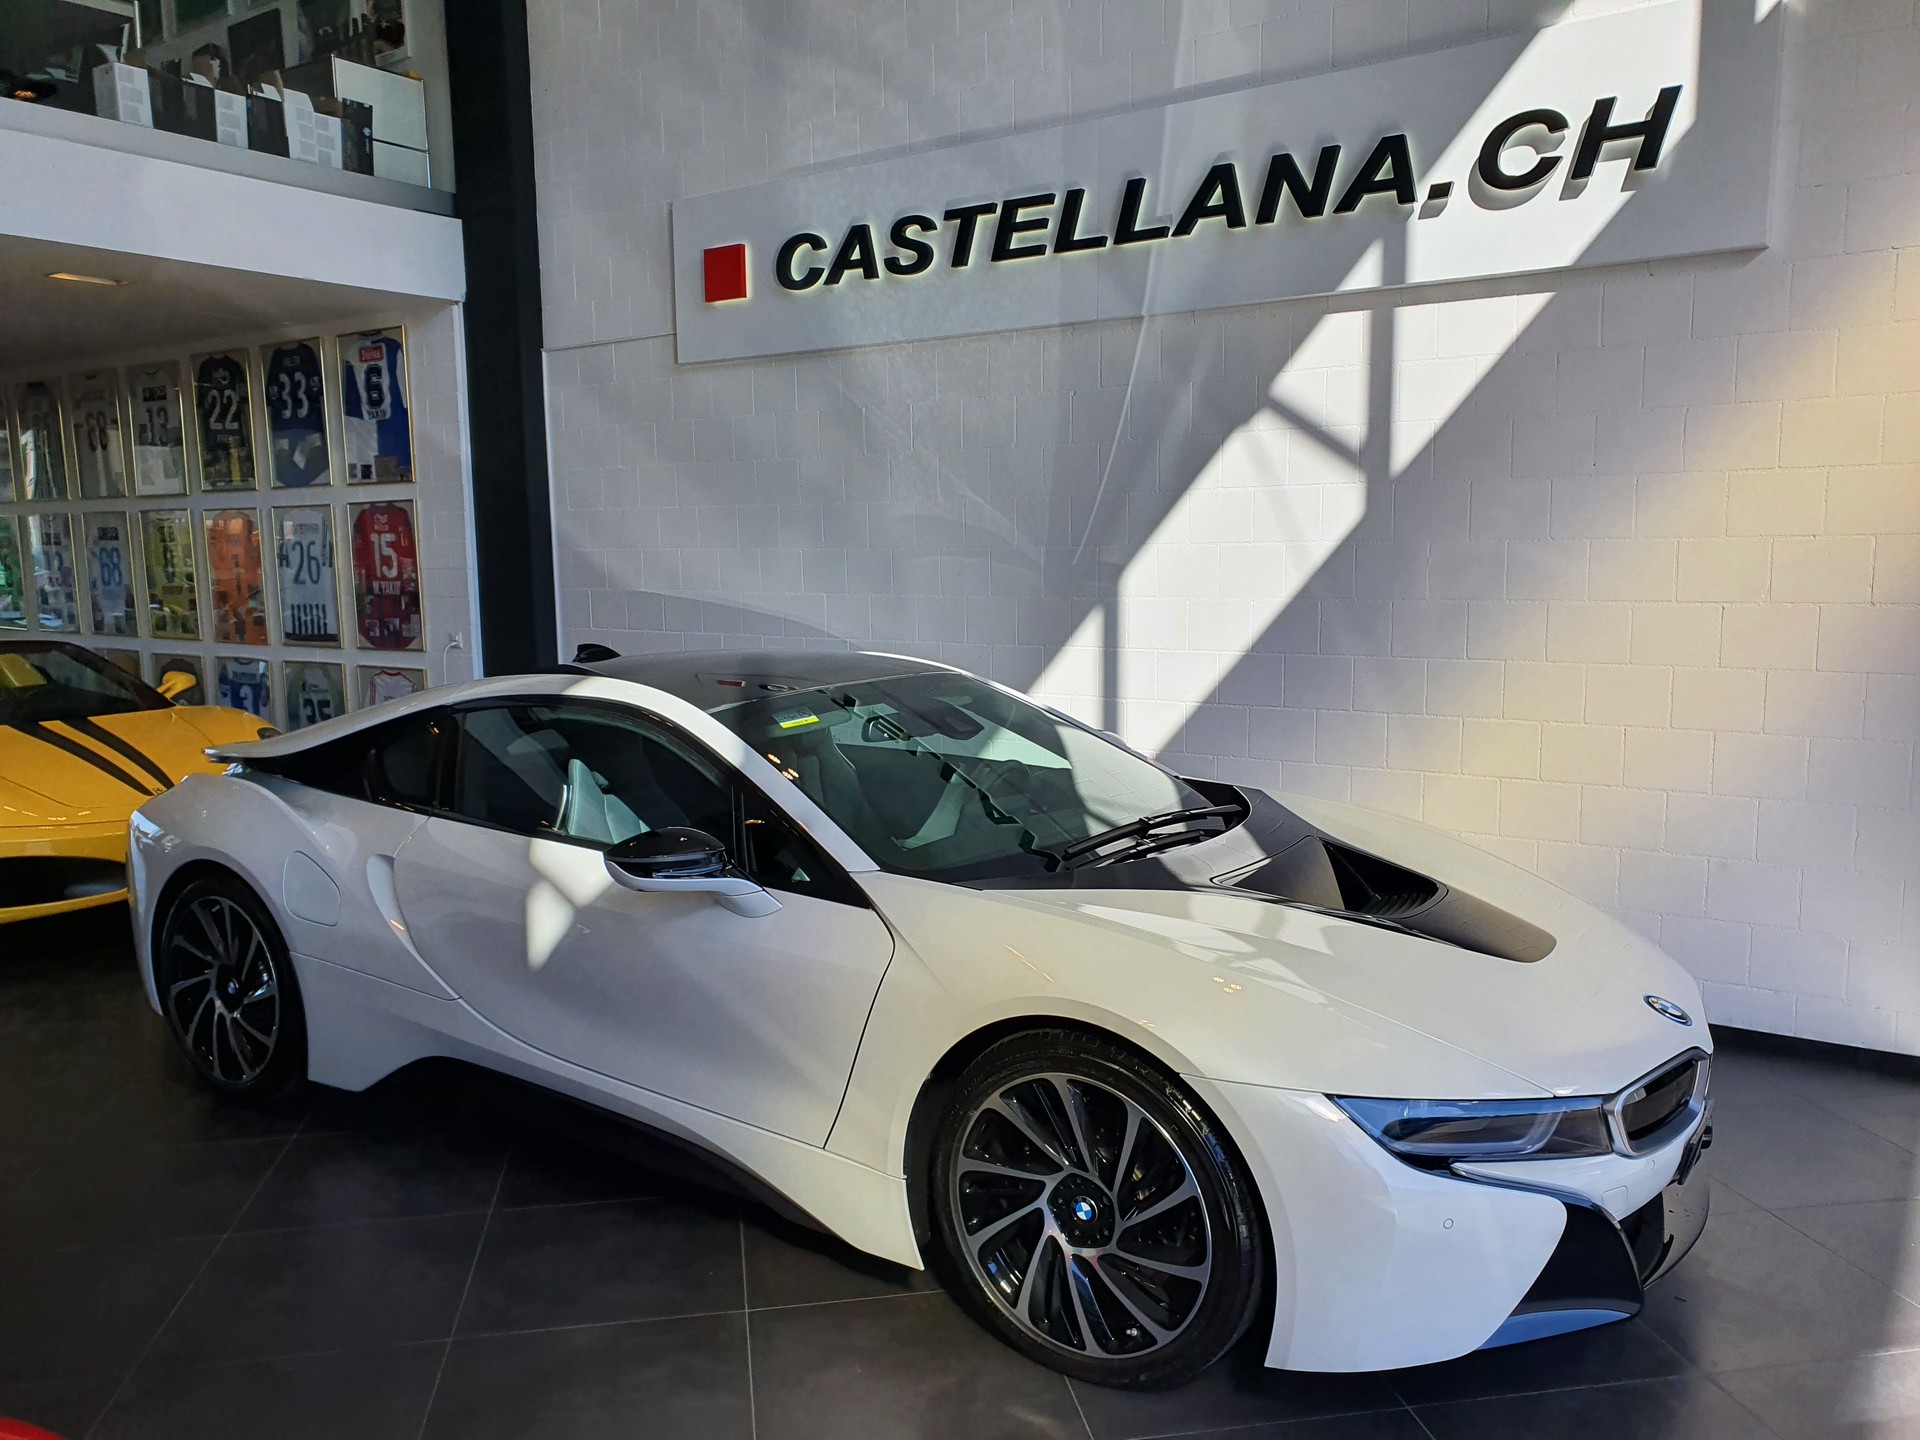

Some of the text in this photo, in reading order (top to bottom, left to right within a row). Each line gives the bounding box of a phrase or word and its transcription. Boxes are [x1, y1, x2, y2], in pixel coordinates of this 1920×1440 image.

[776, 86, 1681, 290] CASTELLANA.CH
[279, 372, 309, 419] 33
[364, 364, 385, 408] 6
[207, 389, 239, 429] 22
[99, 547, 123, 587] 68
[292, 541, 321, 585] 26
[370, 533, 398, 579] 15
